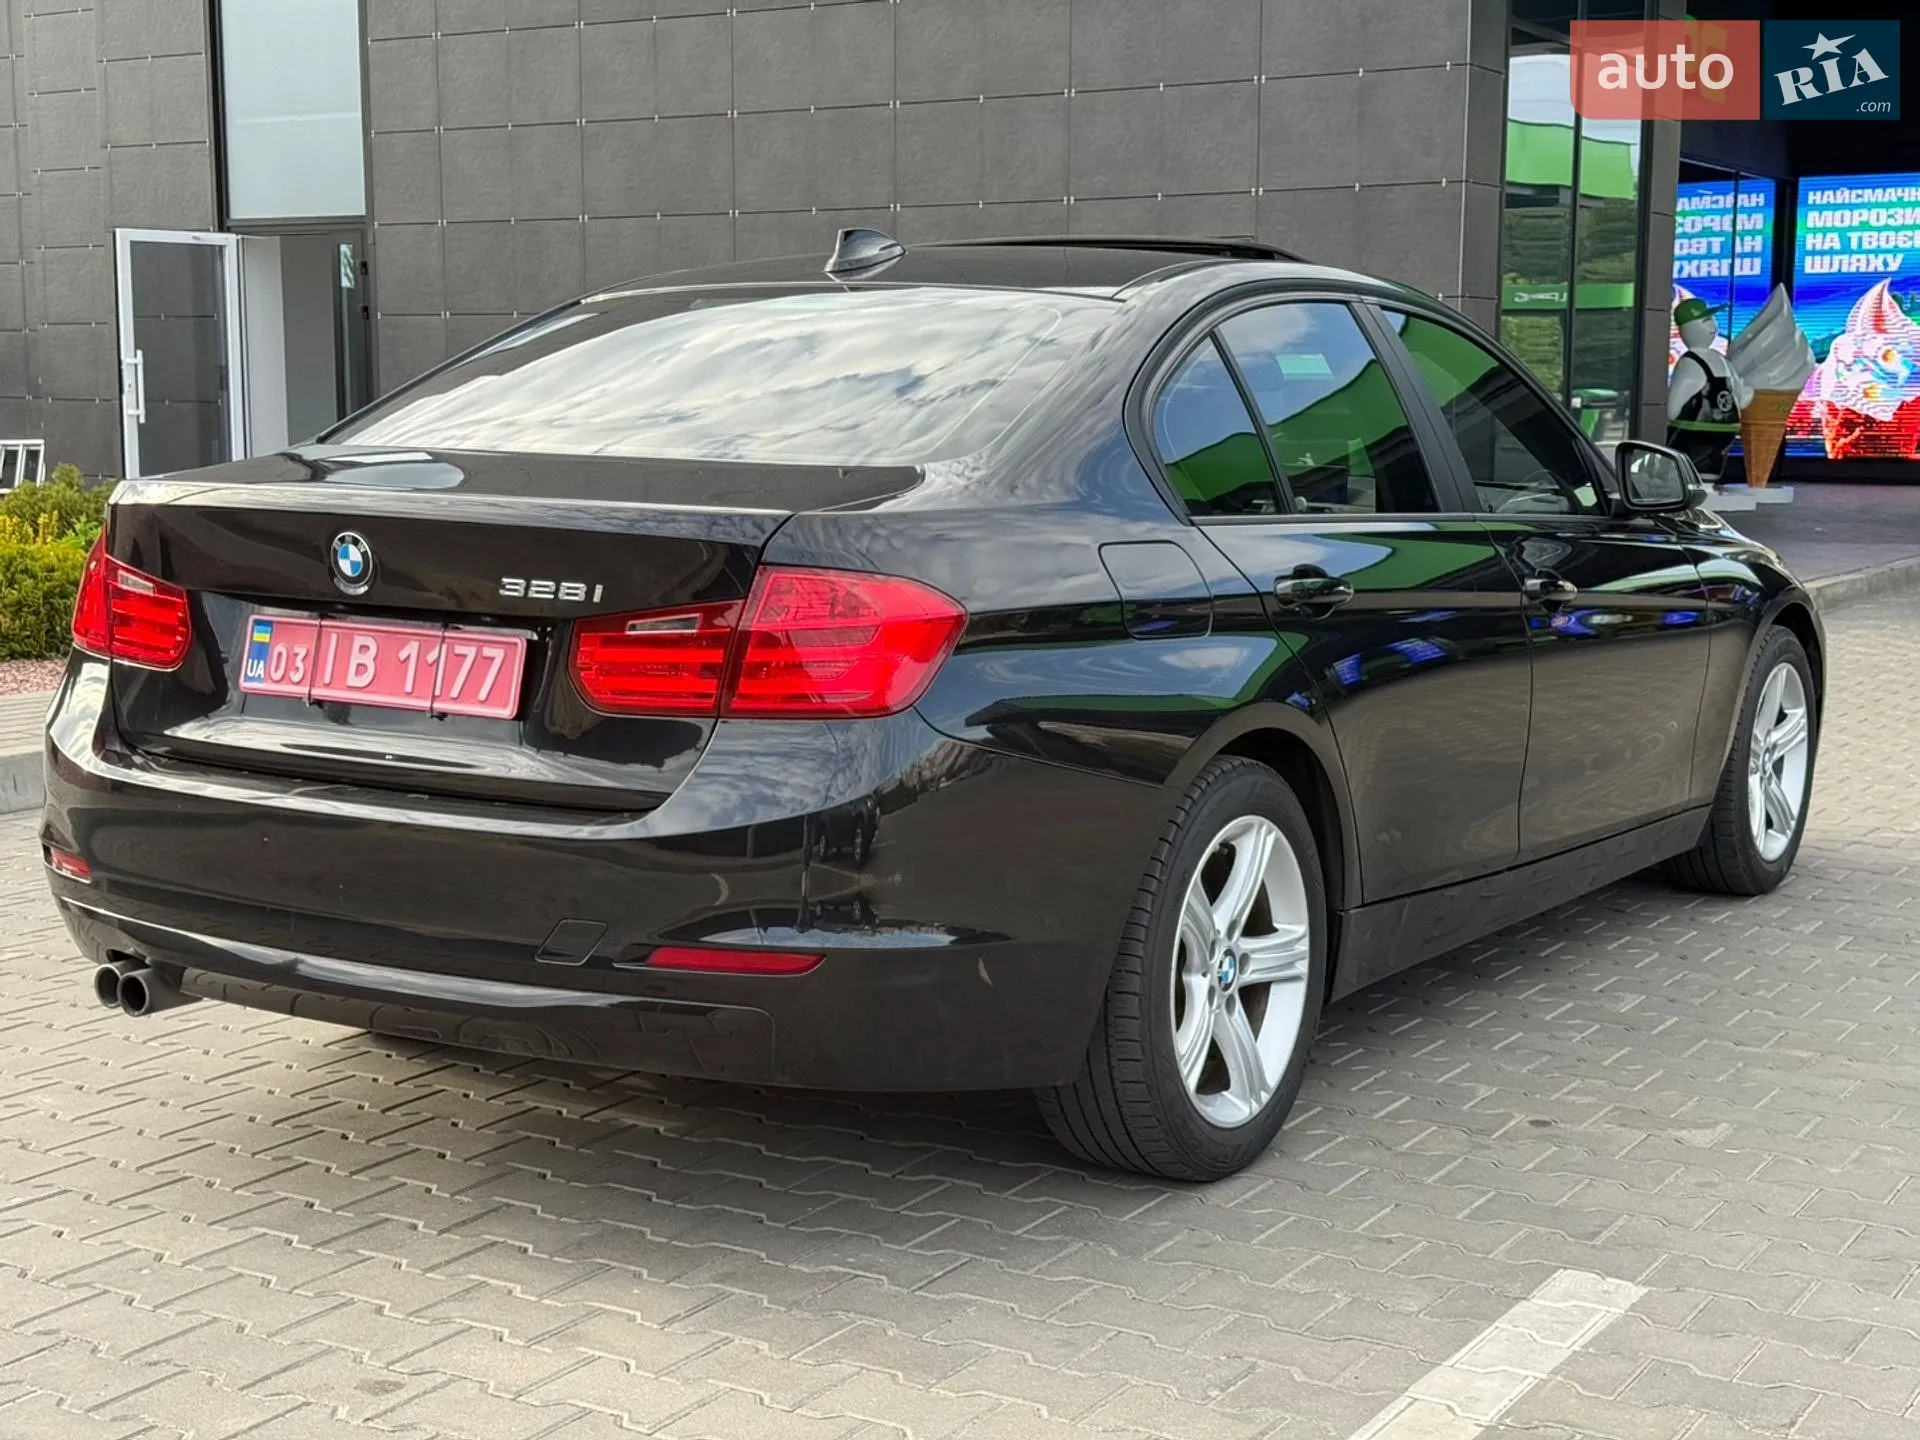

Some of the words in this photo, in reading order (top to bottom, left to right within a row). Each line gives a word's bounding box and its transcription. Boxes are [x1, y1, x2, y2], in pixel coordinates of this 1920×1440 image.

[1805, 231, 1841, 251] НА
[1804, 253, 1904, 274] ШЛЯХУ
[246, 658, 265, 680] UA
[269, 641, 306, 684] 03
[397, 640, 506, 702] 1177
